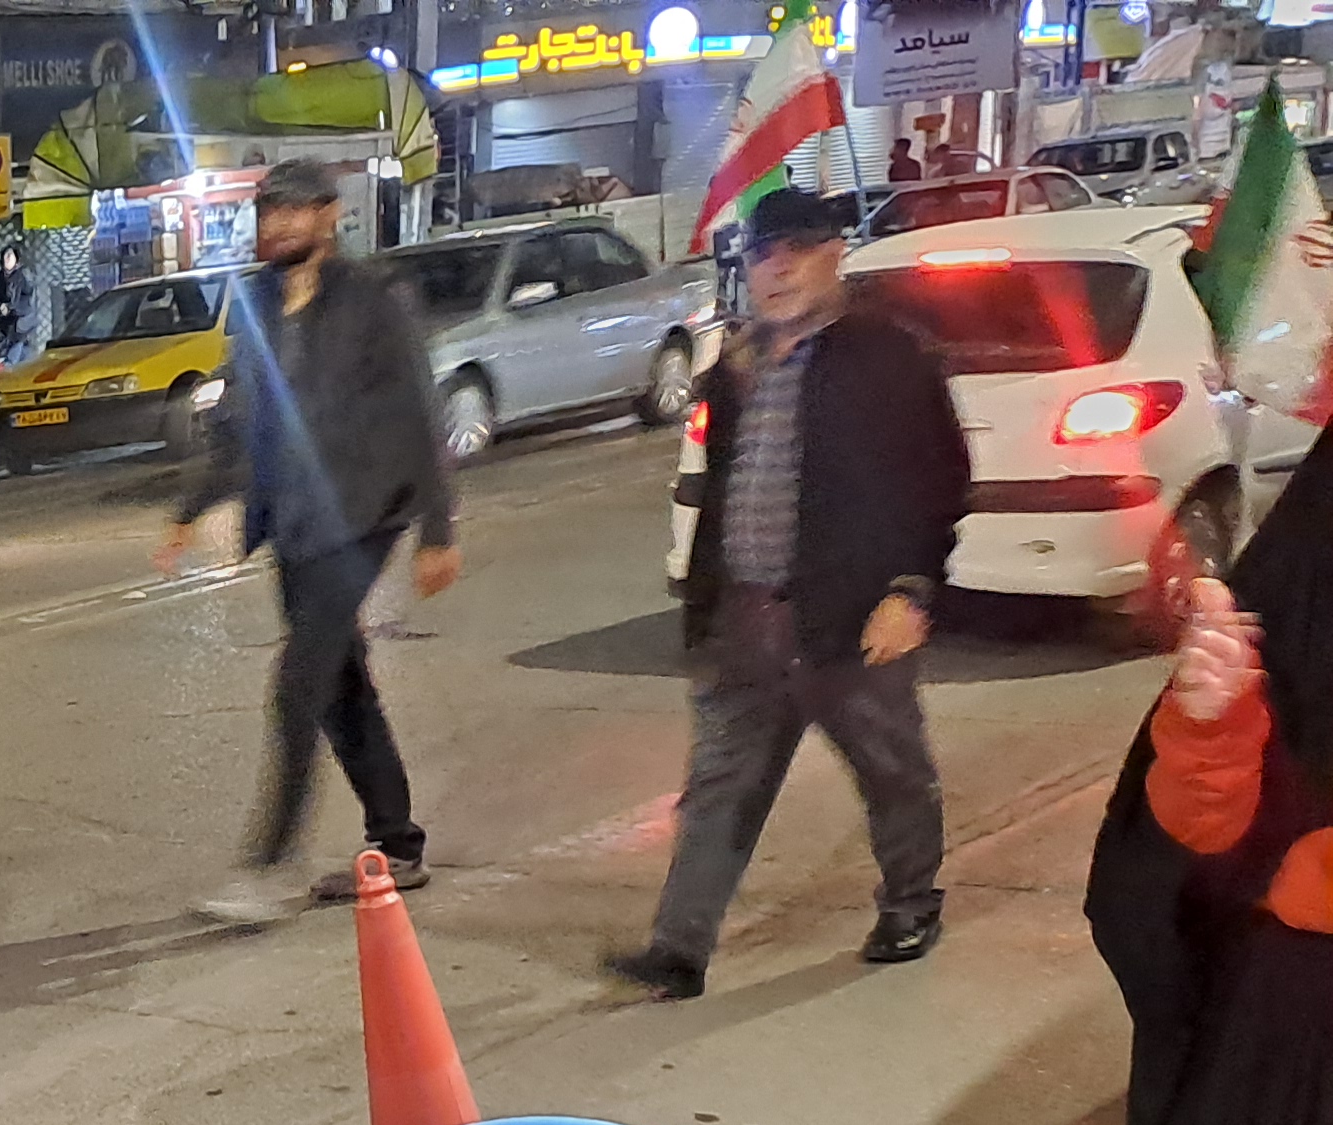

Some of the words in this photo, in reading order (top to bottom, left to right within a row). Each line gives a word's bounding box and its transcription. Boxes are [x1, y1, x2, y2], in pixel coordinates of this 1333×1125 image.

[483, 25, 599, 72] تجارت
[561, 31, 645, 74] بانک
[2, 60, 43, 89] MELLI
[46, 58, 83, 87] SHOE
